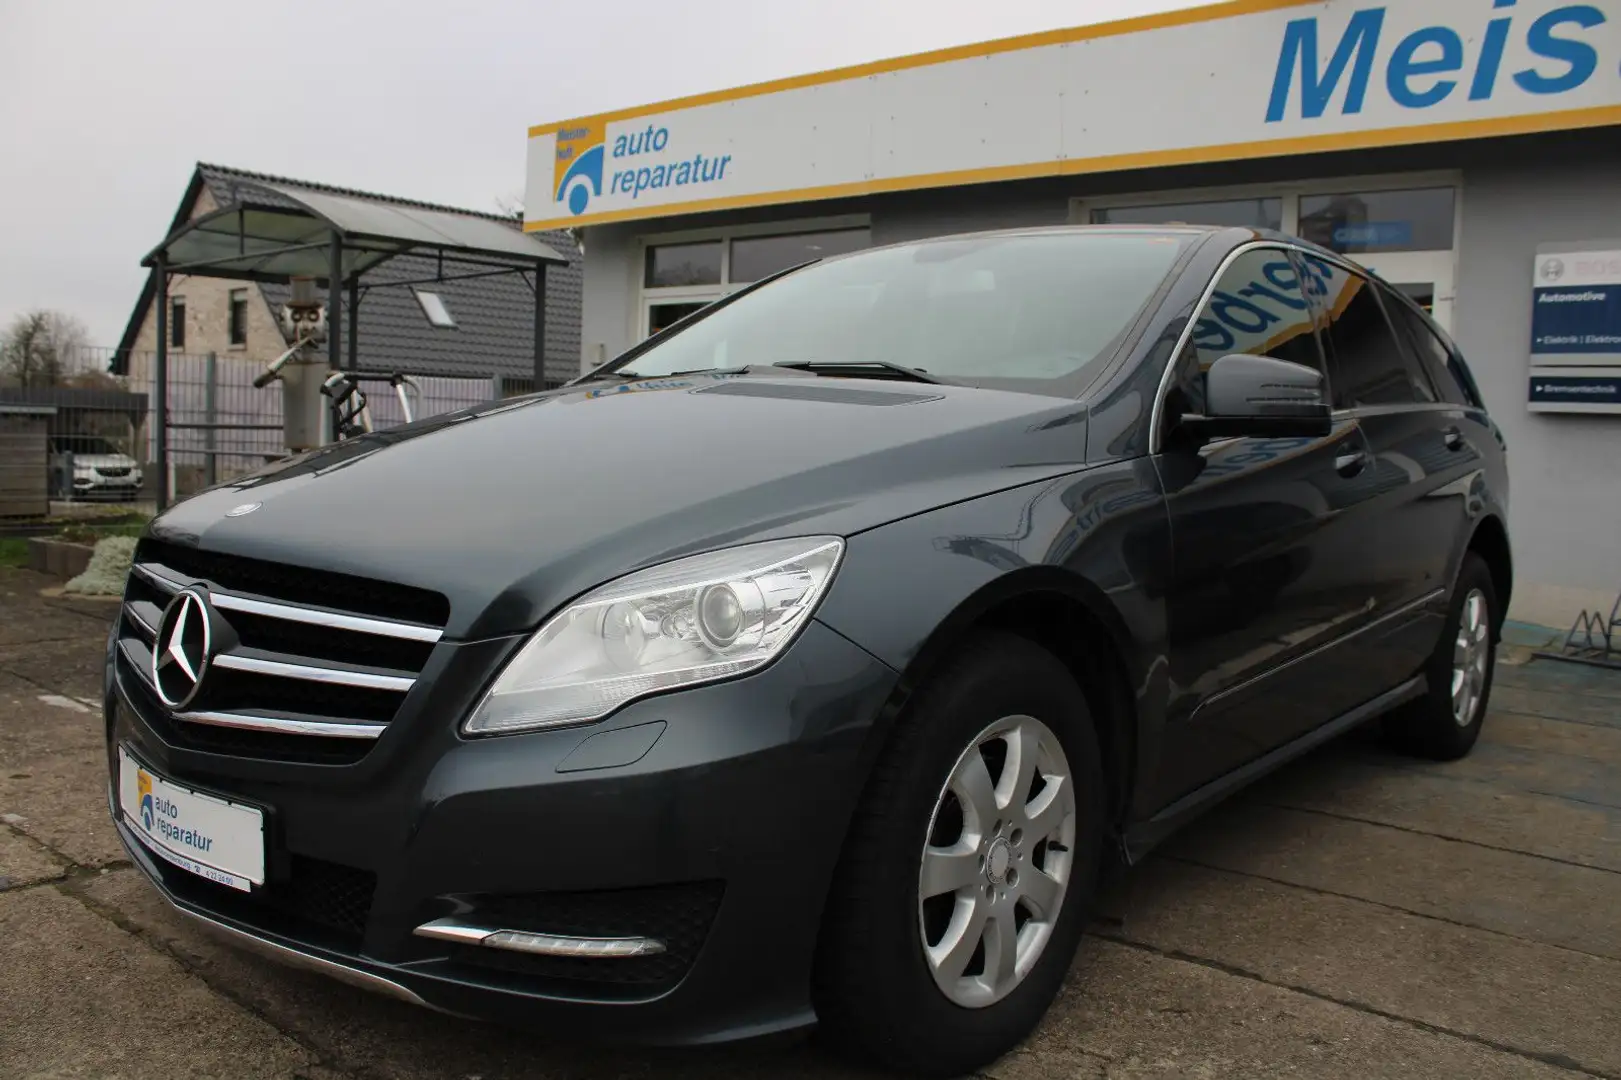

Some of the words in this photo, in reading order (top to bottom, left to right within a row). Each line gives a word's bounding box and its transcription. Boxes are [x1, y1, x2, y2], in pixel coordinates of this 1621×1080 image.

[1264, 0, 1621, 123] Meis
[612, 124, 669, 158] auto
[611, 154, 732, 200] reparatur
[1538, 291, 1607, 304] Automotive
[155, 796, 178, 819] auto
[157, 817, 213, 852] reparatur
